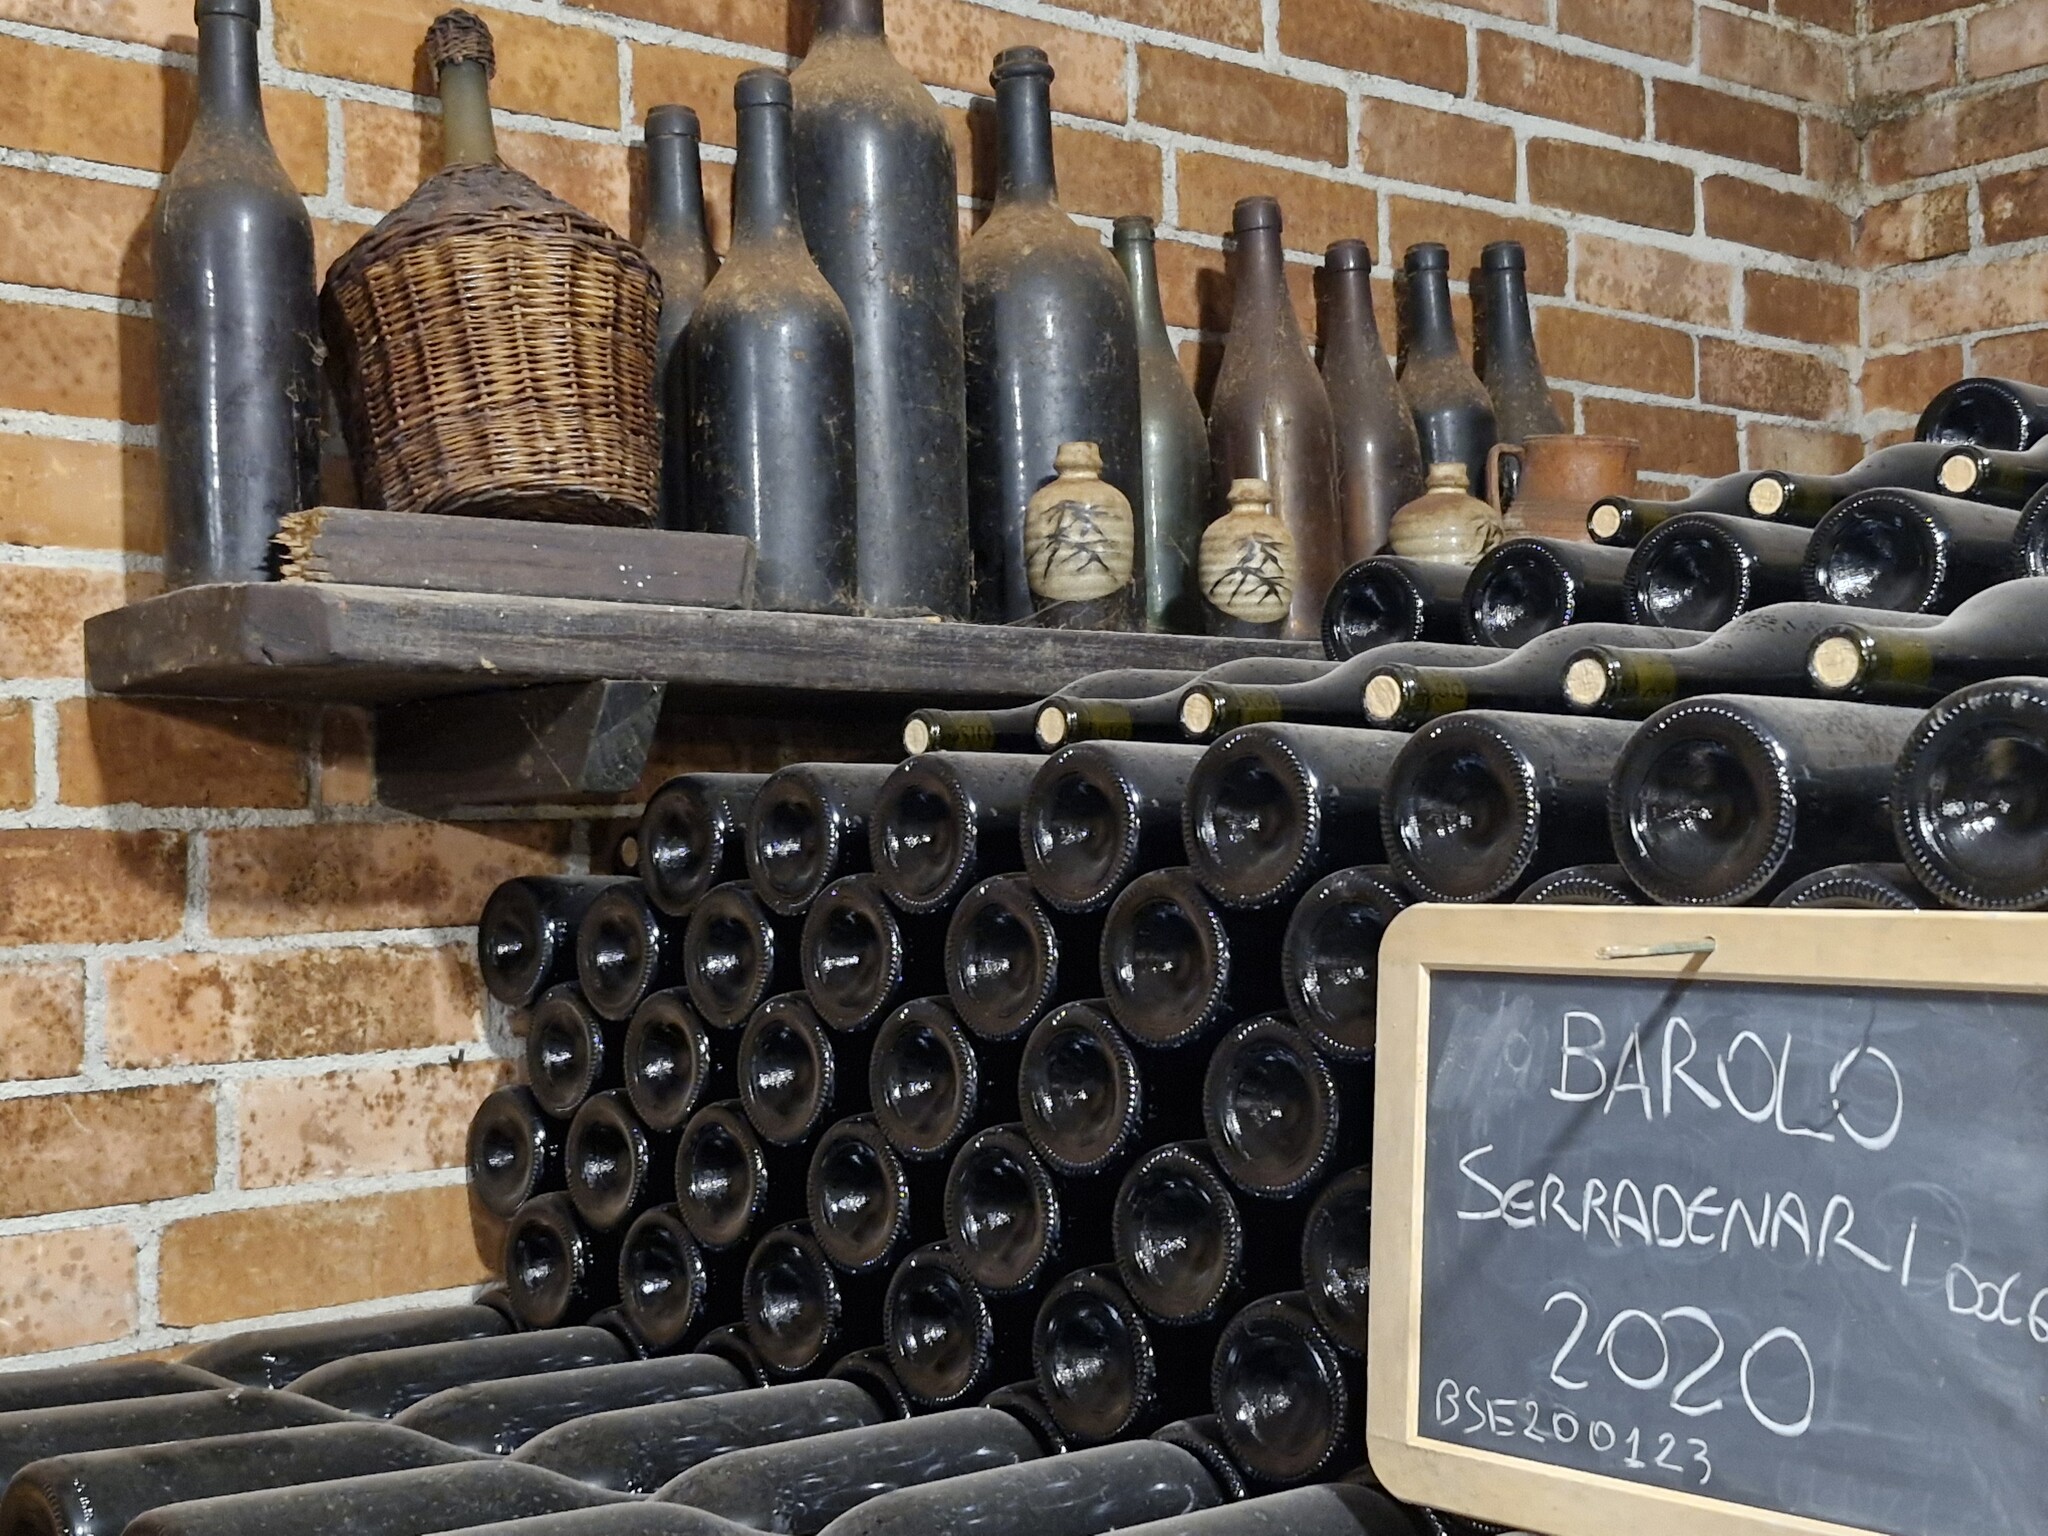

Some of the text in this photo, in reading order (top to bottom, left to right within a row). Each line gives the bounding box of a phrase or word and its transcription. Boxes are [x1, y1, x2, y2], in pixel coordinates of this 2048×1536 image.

[1551, 1010, 1903, 1151] BAROLO
[1457, 1144, 1918, 1287] SERRADENARI
[1435, 1378, 1712, 1485] BSE200123
[1543, 1291, 1816, 1438] 2020
